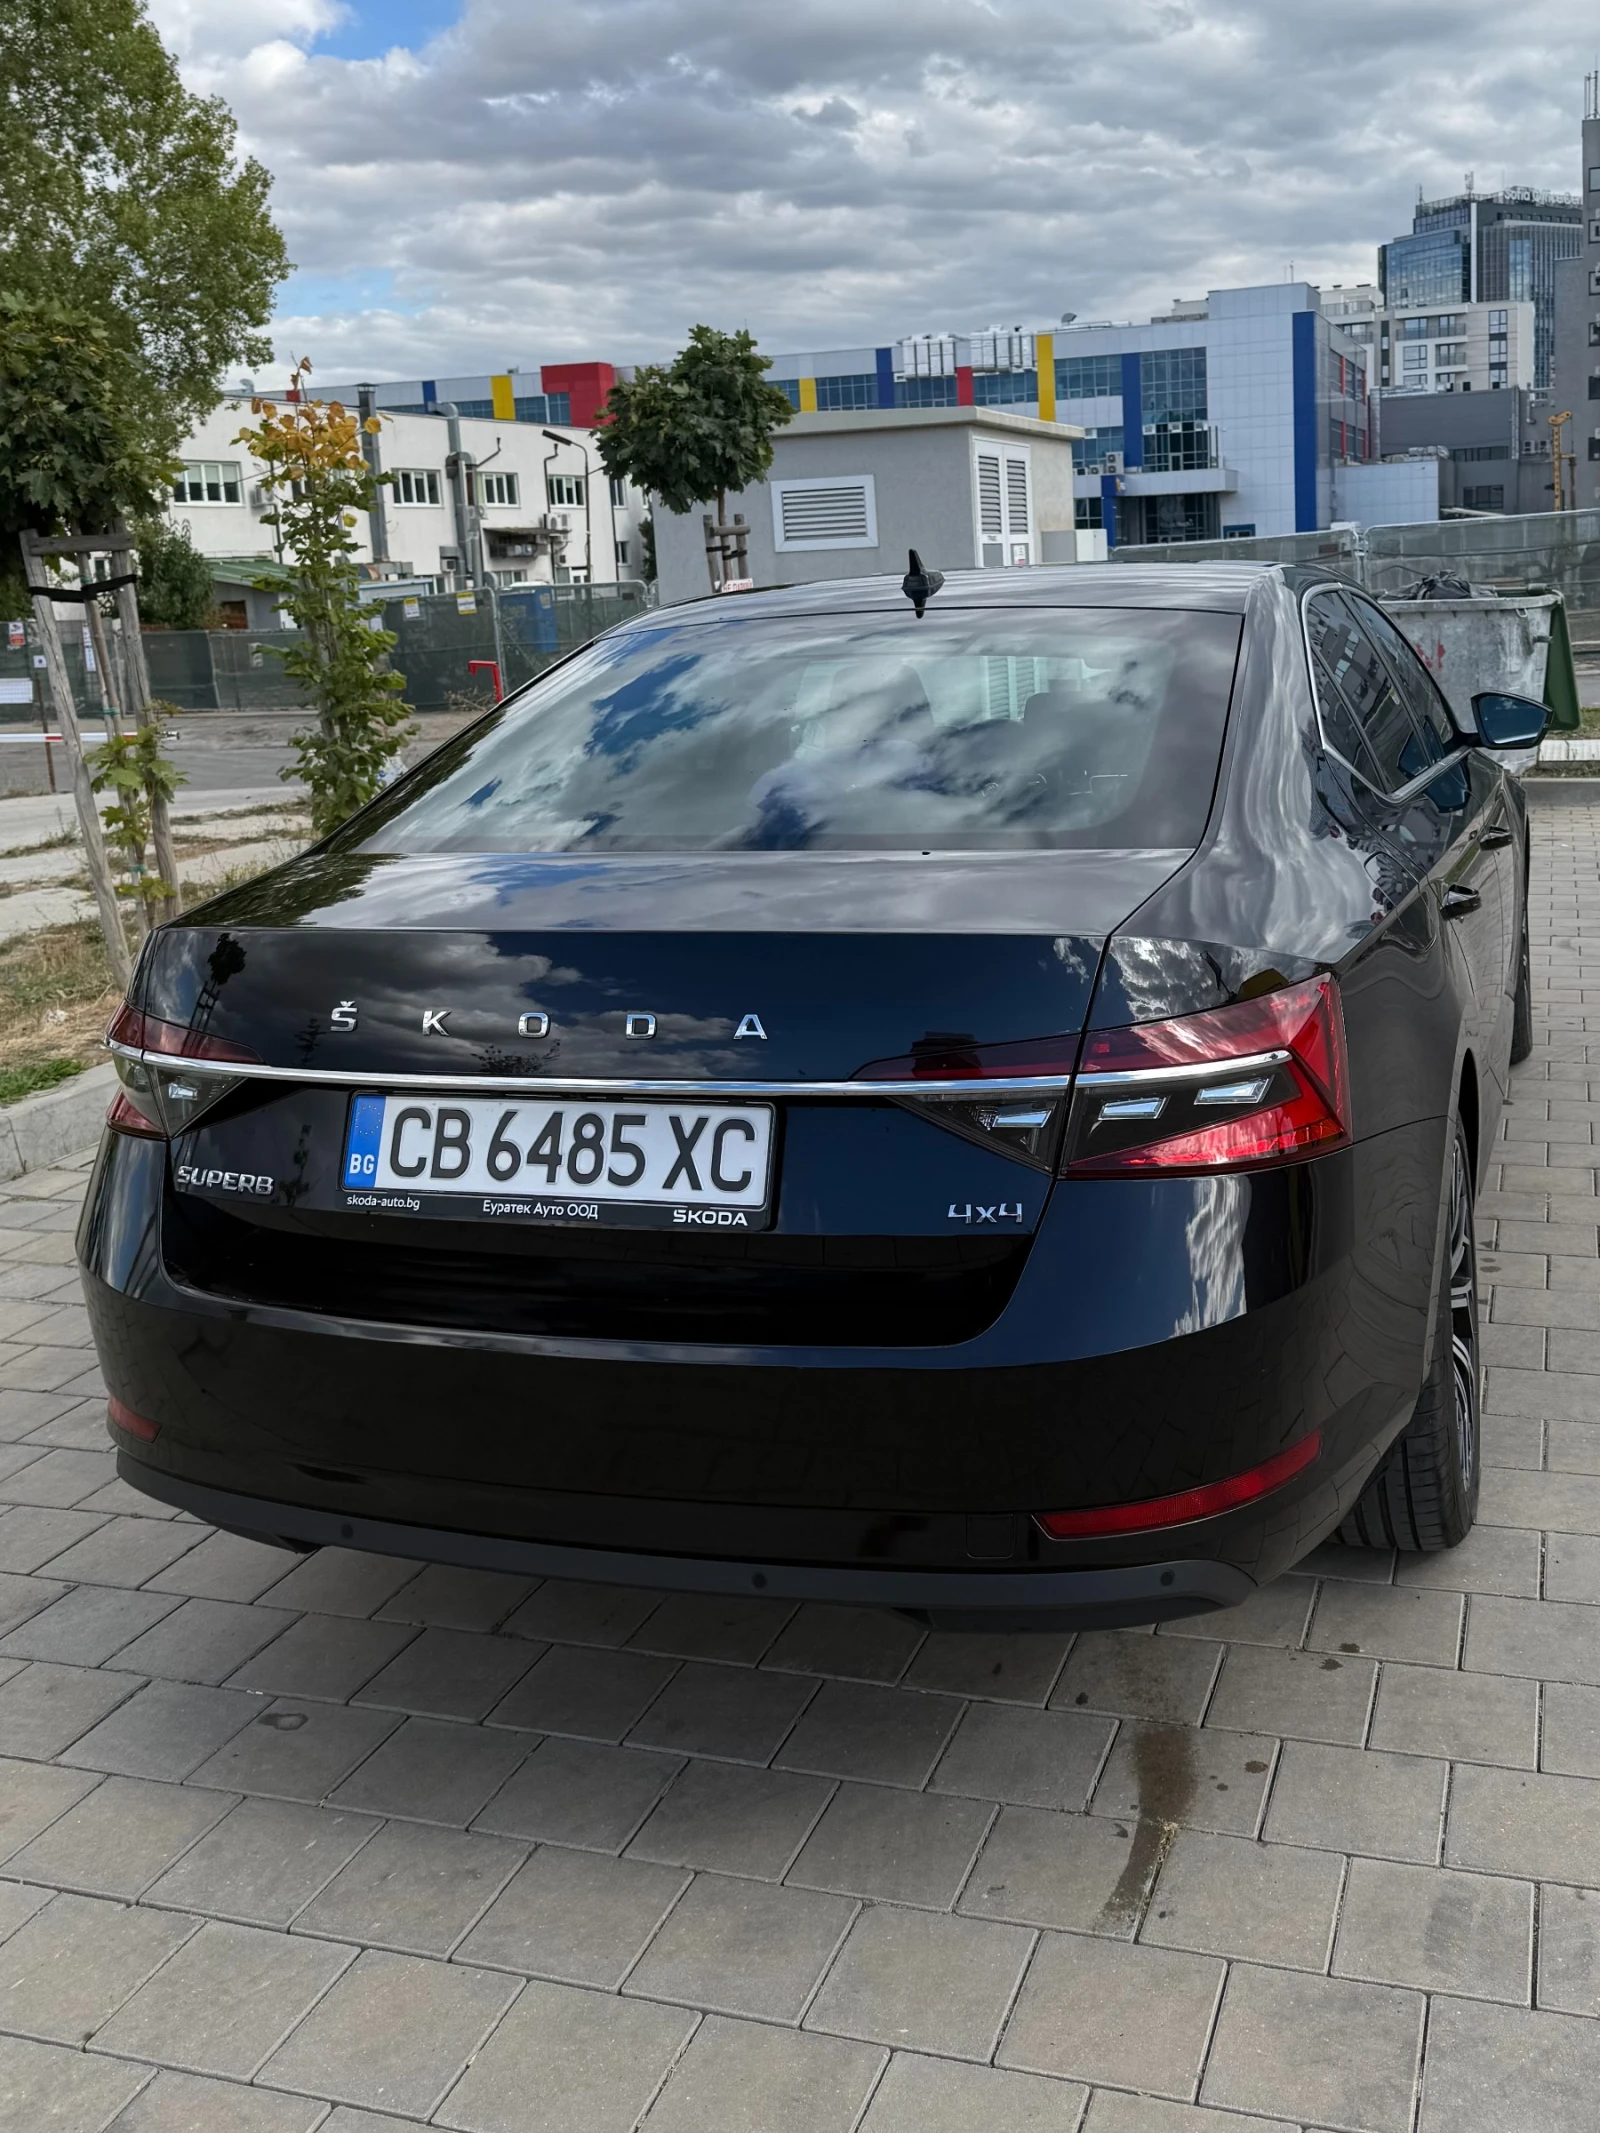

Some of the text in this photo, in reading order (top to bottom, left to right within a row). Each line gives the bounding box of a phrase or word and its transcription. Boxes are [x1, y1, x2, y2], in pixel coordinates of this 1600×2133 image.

[1504, 188, 1531, 202] Sofia
[330, 1000, 768, 1040] ŠKODA
[389, 1107, 755, 1192] CB 6485 XC
[349, 1153, 375, 1175] BG
[177, 1165, 274, 1195] SUPERB
[346, 1194, 421, 1211] skoda-auto.bg
[482, 1199, 599, 1220] Еуратек Ауто ООД
[947, 1202, 1023, 1224] 4x4
